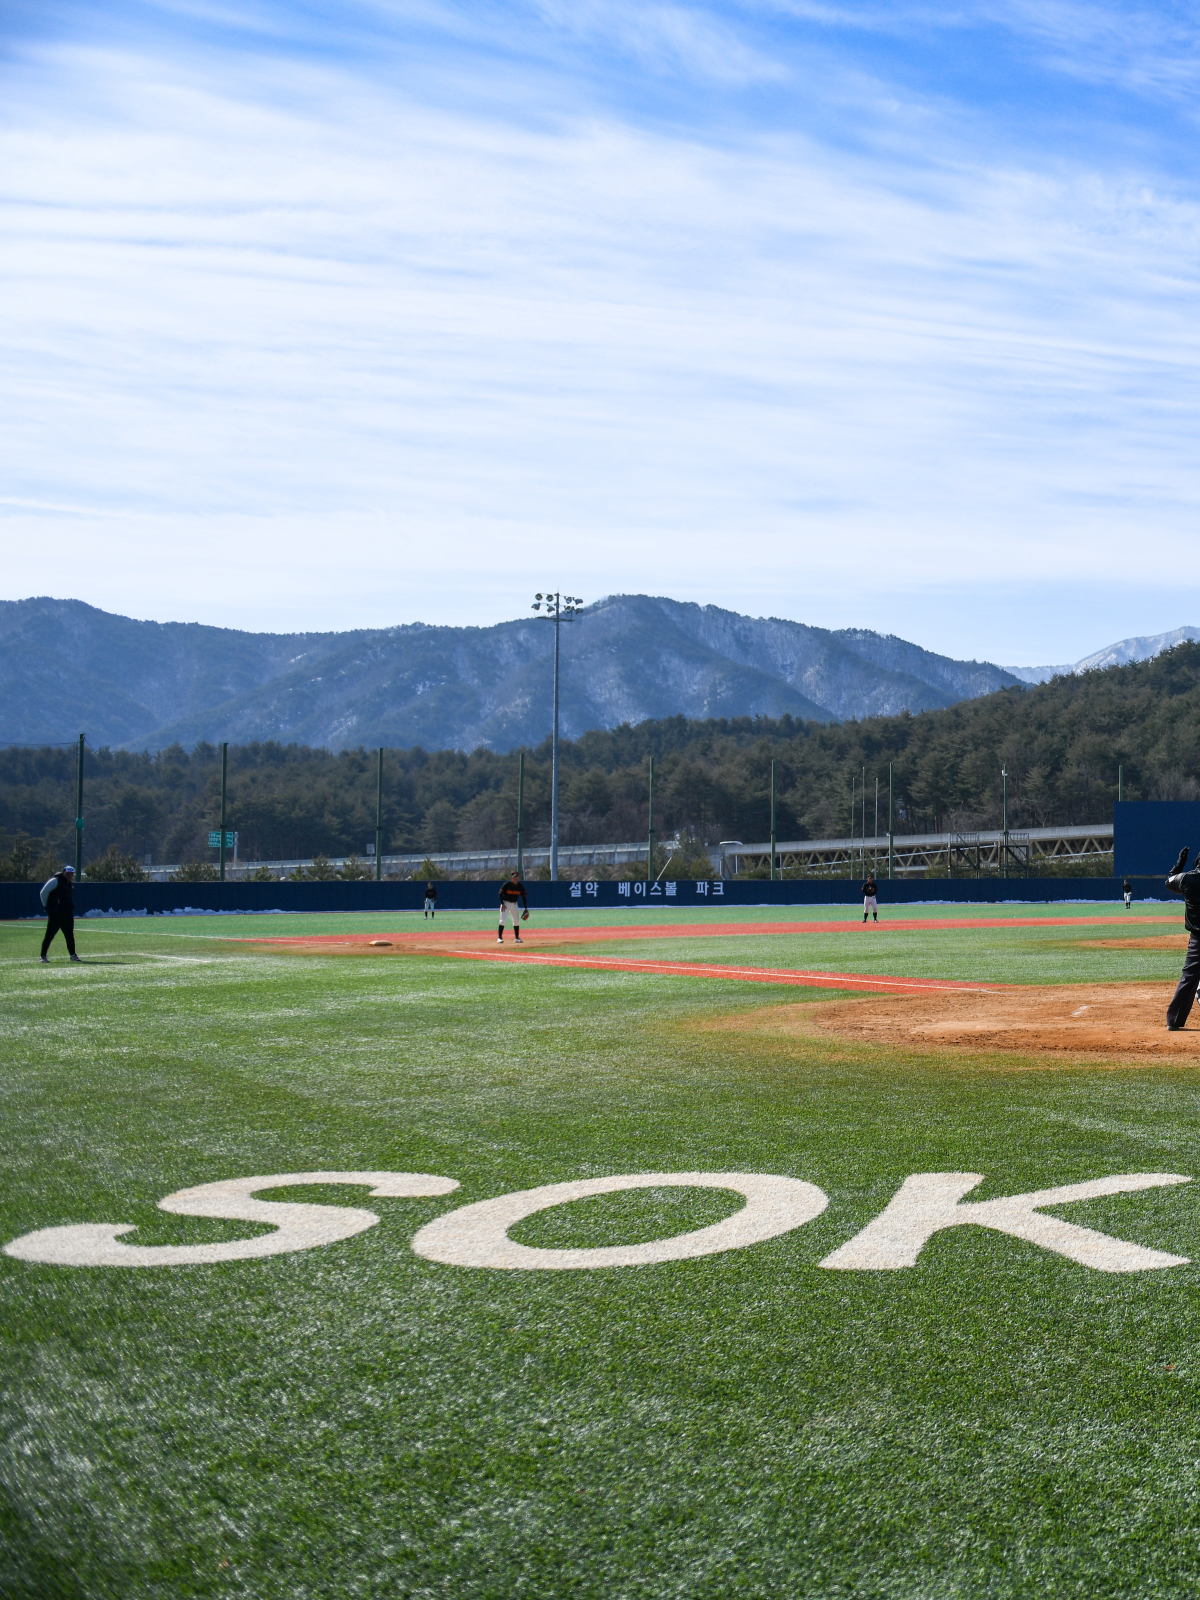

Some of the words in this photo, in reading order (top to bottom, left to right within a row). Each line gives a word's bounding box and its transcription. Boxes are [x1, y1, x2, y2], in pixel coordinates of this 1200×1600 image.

[569, 882, 599, 898] 설악
[618, 881, 678, 897] 베이스볼
[695, 881, 725, 896] 파크
